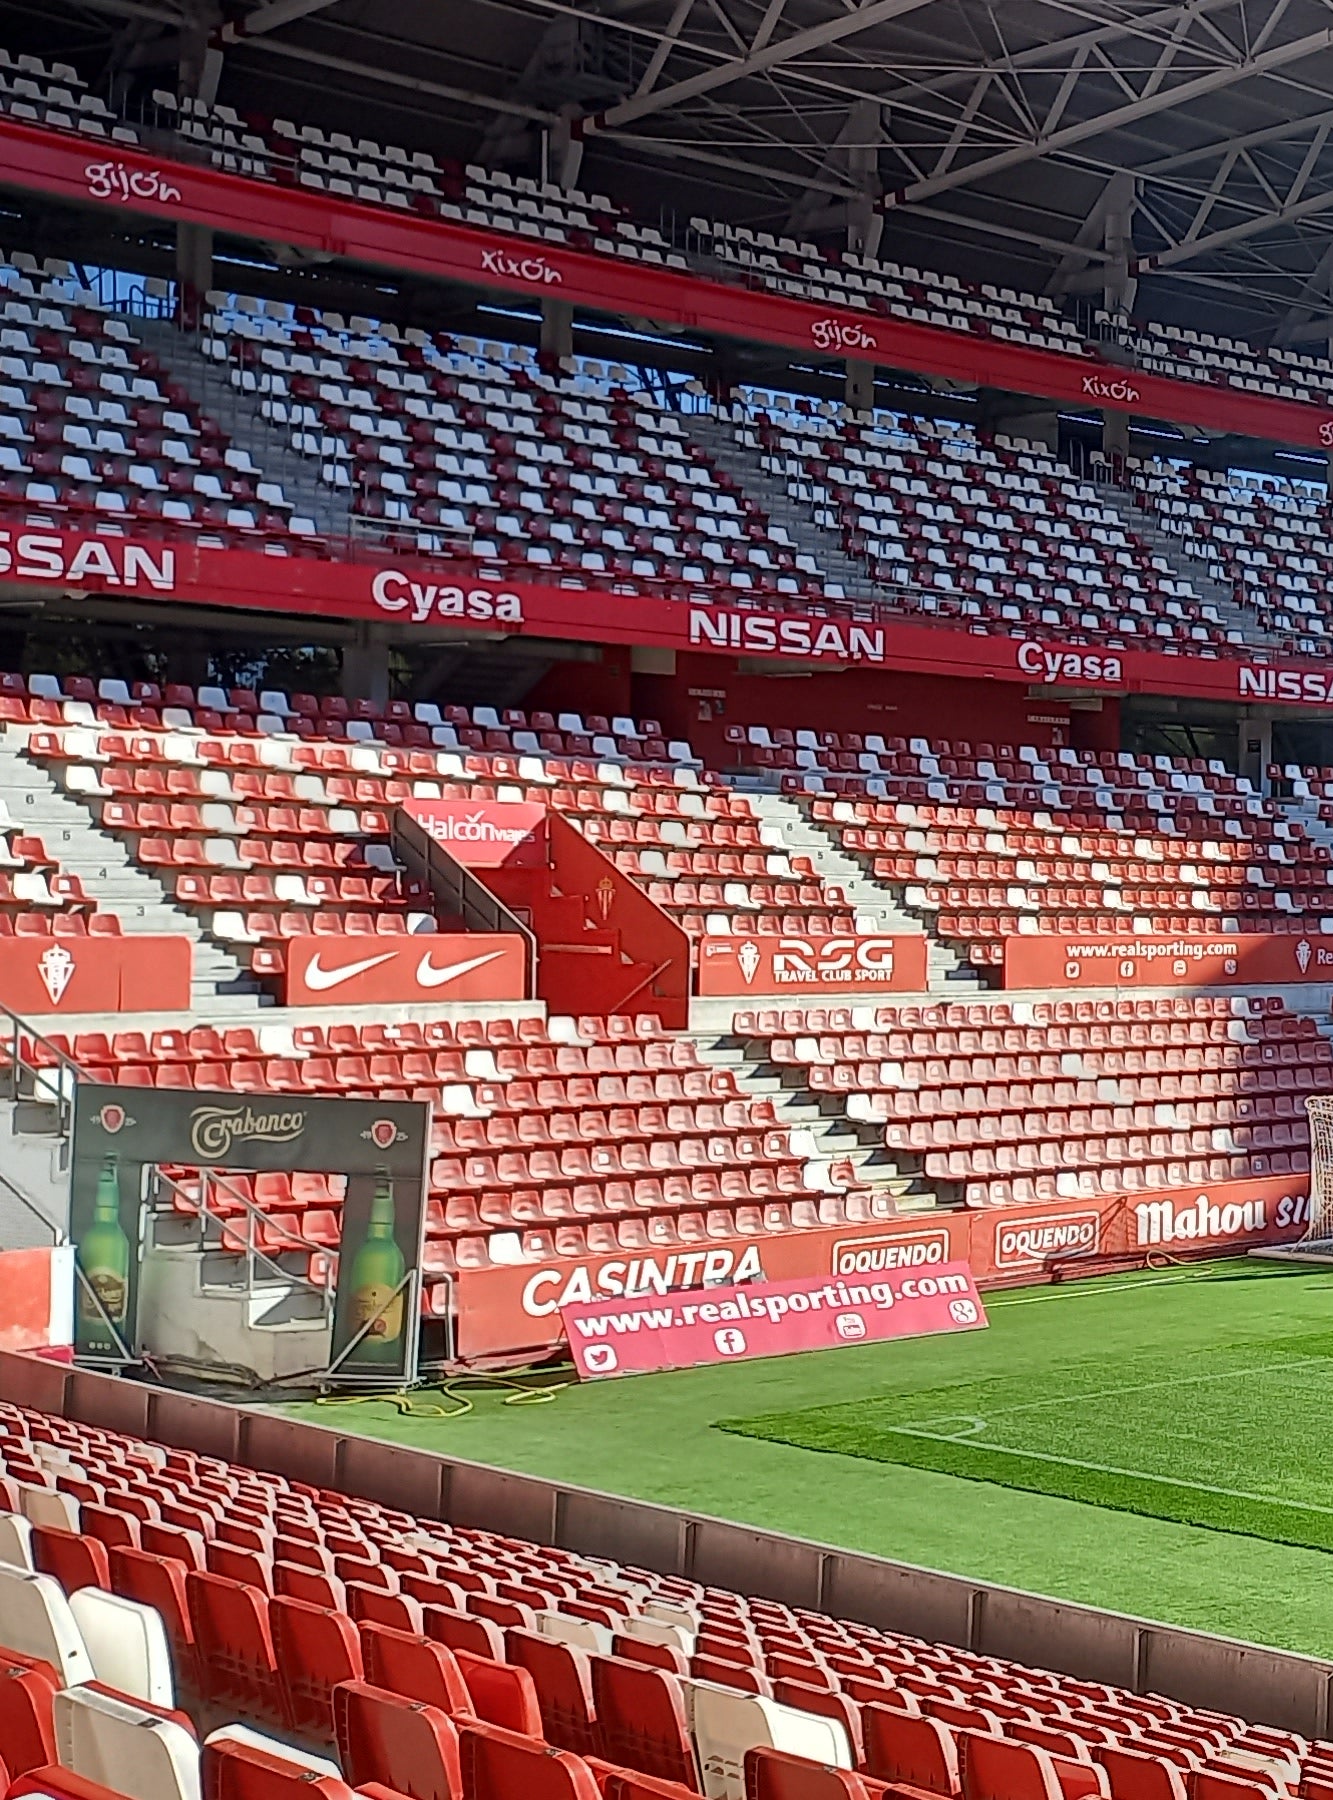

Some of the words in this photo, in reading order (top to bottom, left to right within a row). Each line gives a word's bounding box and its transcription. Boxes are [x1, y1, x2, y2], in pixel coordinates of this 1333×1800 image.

[84, 161, 181, 201] gijón
[811, 319, 877, 351] gijón
[0, 538, 174, 590] SAN
[372, 570, 523, 624] Cyasa
[690, 609, 884, 662] NISSAN
[1017, 641, 1121, 683] Cyasa
[774, 939, 893, 971] RSG
[1067, 941, 1238, 961] www.realsporting.com
[774, 970, 818, 983] TRAVEL
[821, 970, 851, 982] CLUB
[855, 969, 893, 982] SPORT
[1002, 1224, 1093, 1256] OQUENDO
[1136, 1196, 1265, 1246] Mahou
[839, 1242, 943, 1275] OQUENDO
[522, 1245, 768, 1317] CASINTRA
[574, 1273, 969, 1338] www.realsporting.com
